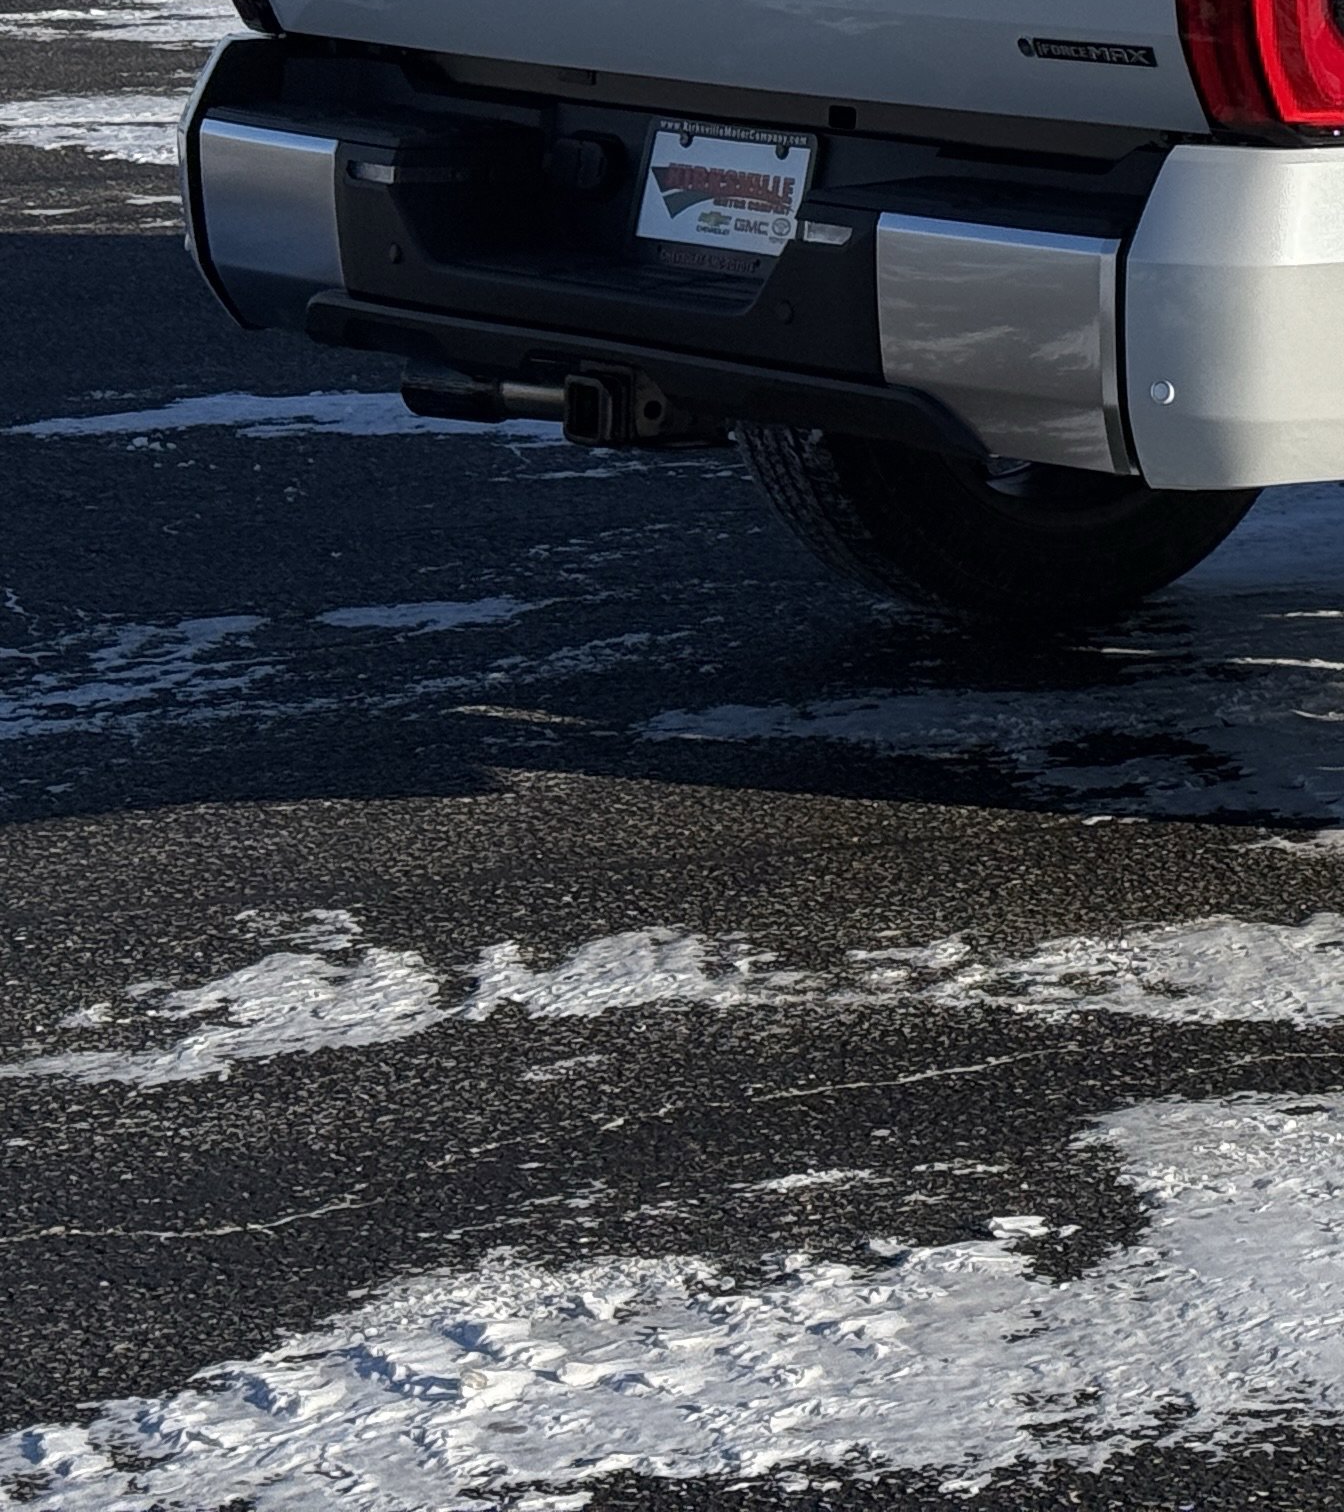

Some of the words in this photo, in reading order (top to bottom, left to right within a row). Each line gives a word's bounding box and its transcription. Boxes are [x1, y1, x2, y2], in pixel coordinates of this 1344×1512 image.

[659, 119, 808, 146] www.KirksvilleMotorCompany.com
[664, 162, 796, 205] KIRKSVILLE
[734, 218, 770, 236] GMC
